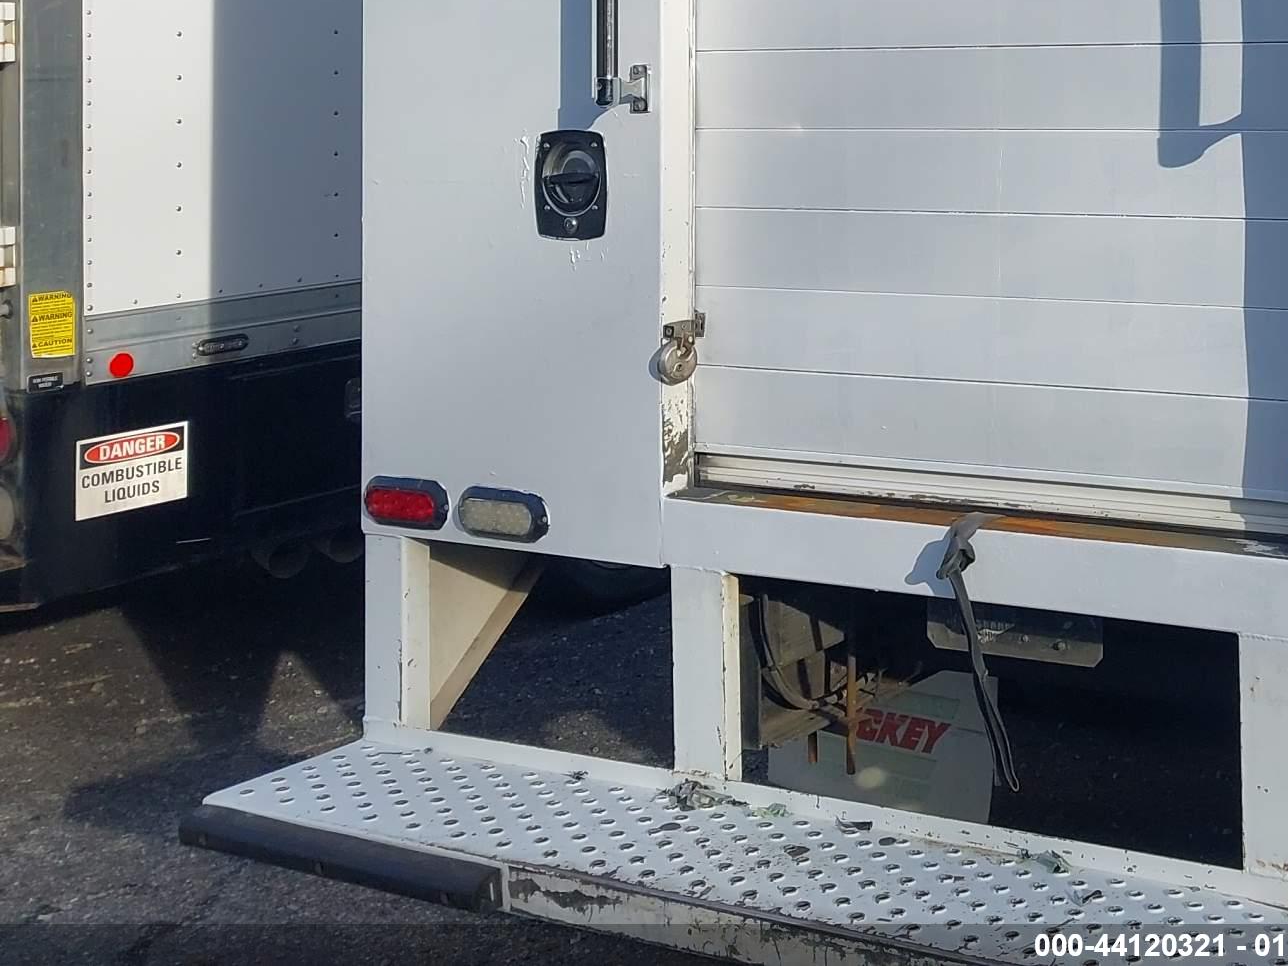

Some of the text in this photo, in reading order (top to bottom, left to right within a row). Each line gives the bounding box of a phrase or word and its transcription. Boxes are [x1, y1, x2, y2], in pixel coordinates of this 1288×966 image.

[39, 312, 73, 321] WARNING
[38, 338, 73, 347] CAUTION
[99, 435, 166, 461] DANGER
[81, 457, 182, 489] COMBUSTIBLE
[104, 480, 160, 503] LIQUIDS
[855, 707, 953, 754] CKEY
